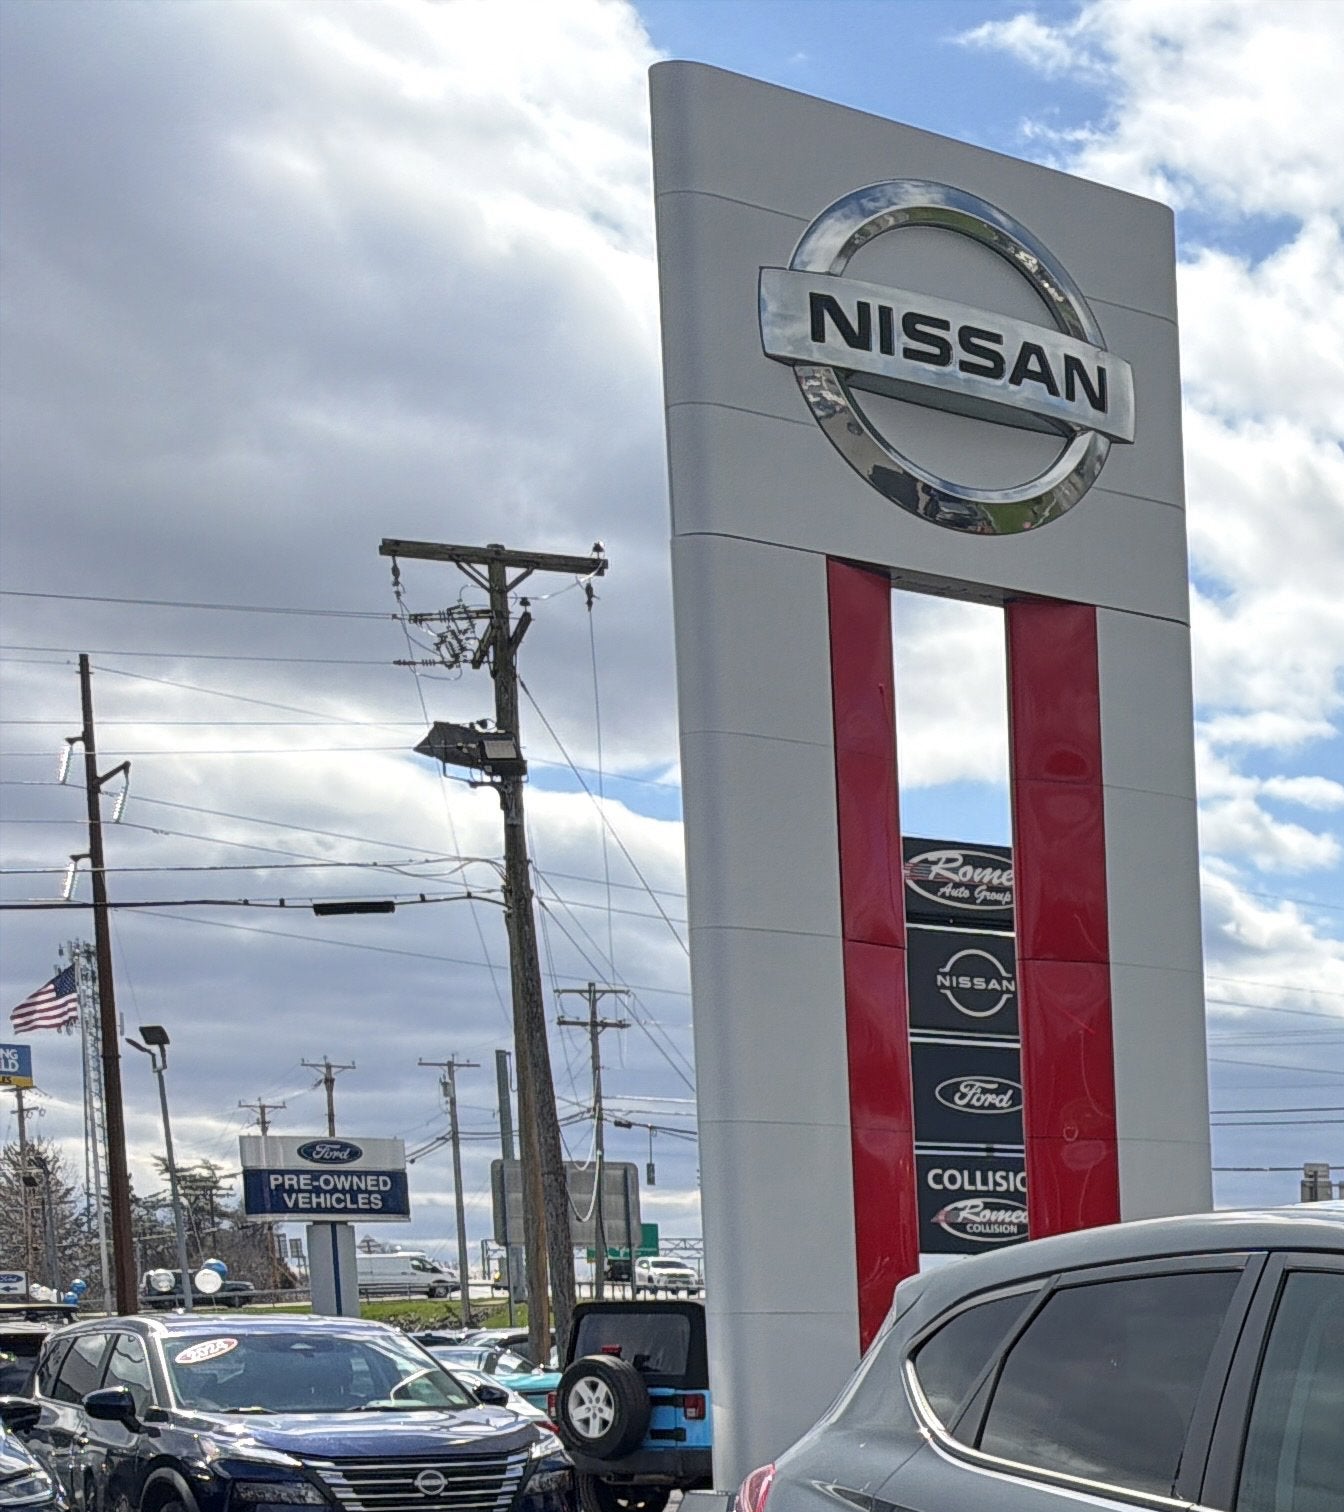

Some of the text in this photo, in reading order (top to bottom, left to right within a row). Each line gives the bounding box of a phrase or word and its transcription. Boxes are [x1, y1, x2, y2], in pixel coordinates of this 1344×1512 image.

[809, 291, 1108, 413] NISSAN
[938, 882, 1011, 905] Auto Group
[936, 975, 1016, 992] NISSAN
[954, 1081, 1013, 1108] Ford
[312, 1144, 351, 1160] Ford
[270, 1174, 392, 1191] PRE-OWNED
[283, 1193, 383, 1210] VEHICLES
[966, 1223, 1018, 1234] COLLISION
